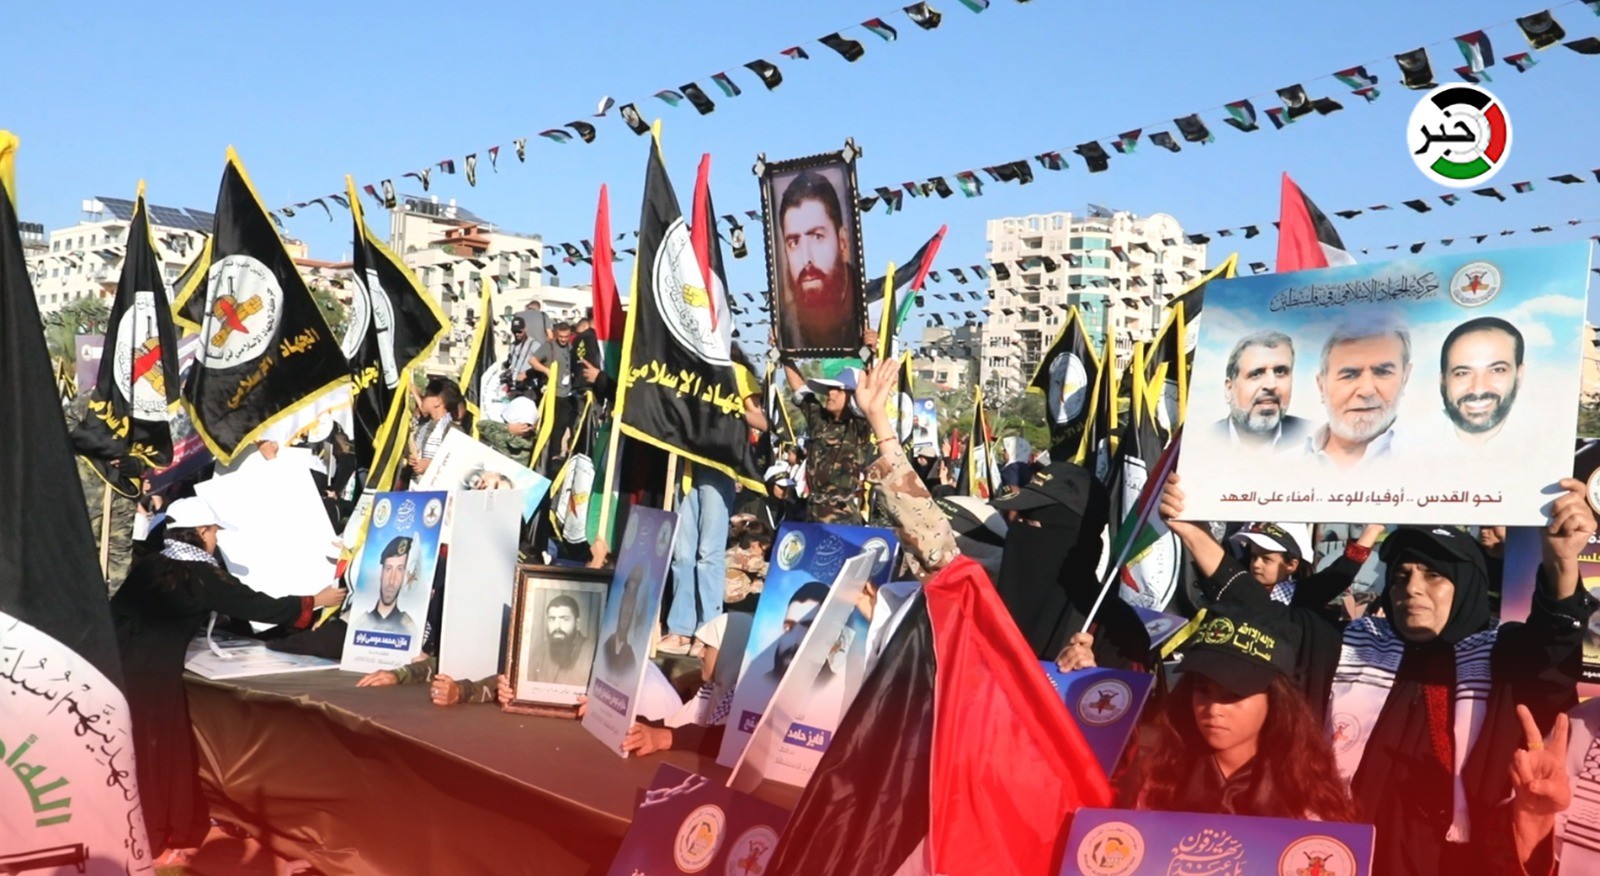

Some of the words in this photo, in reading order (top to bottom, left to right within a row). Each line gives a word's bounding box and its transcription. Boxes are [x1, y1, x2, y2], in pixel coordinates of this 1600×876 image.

[1377, 275, 1411, 302] الجهاد
[1410, 271, 1439, 300] حركة
[1270, 284, 1319, 312] فلسطين
[1319, 290, 1335, 308] في
[279, 327, 320, 358] الجهاد
[625, 359, 702, 399] الإسلامي
[702, 383, 745, 420] جهاد
[1219, 491, 1257, 503] العهد
[1257, 491, 1284, 506] على
[1327, 491, 1364, 506] للوعد
[1417, 490, 1469, 507] القدس
[1472, 491, 1503, 508] نحو
[1233, 634, 1272, 661] سرايا
[787, 729, 806, 741] حامد
[805, 731, 825, 747] فايز
